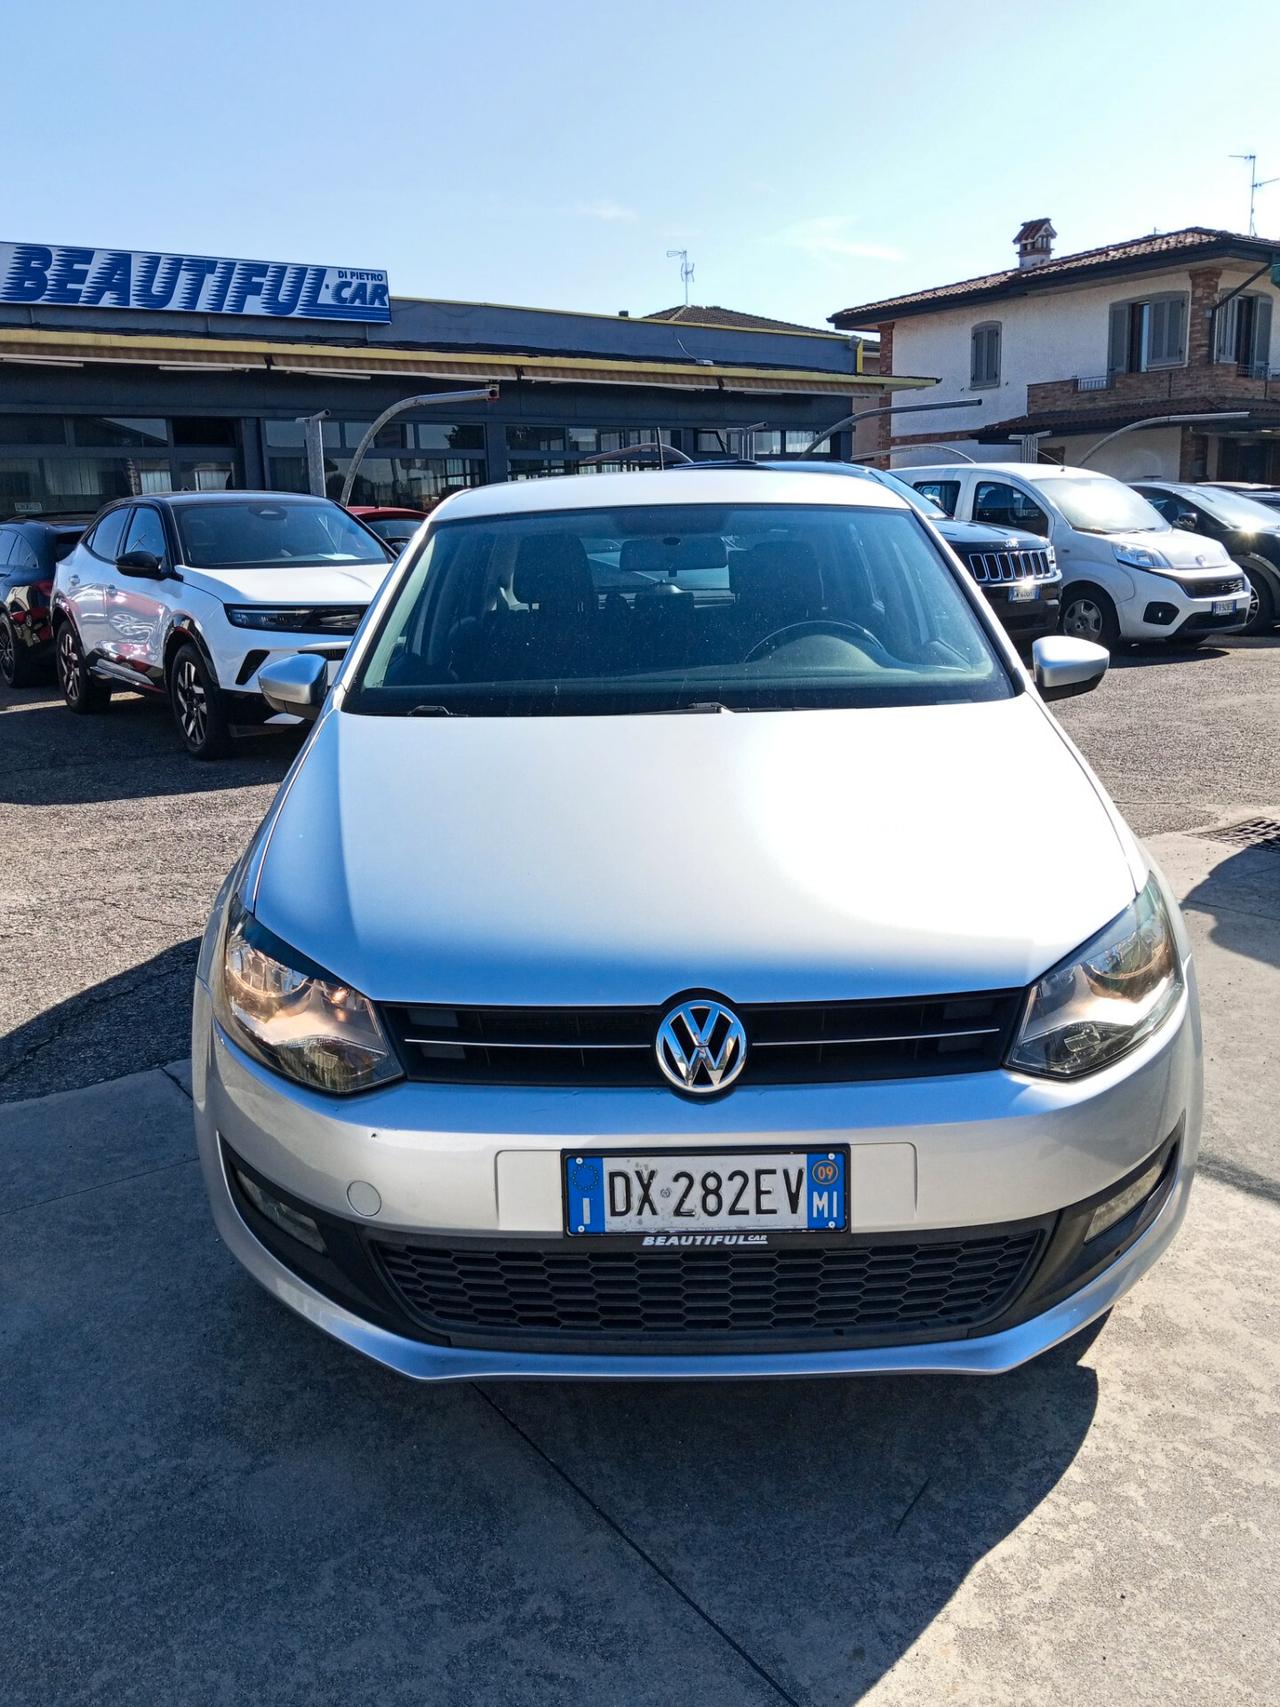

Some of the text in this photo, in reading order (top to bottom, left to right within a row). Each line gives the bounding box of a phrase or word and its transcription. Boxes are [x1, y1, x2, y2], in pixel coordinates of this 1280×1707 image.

[0, 245, 330, 316] BEAUTIFUL
[337, 270, 384, 282] DI PIETRO
[330, 280, 388, 307] CAR
[816, 1166, 834, 1180] 09
[812, 1191, 839, 1219] MI
[642, 1234, 768, 1246] BEAUTIFUL CAR
